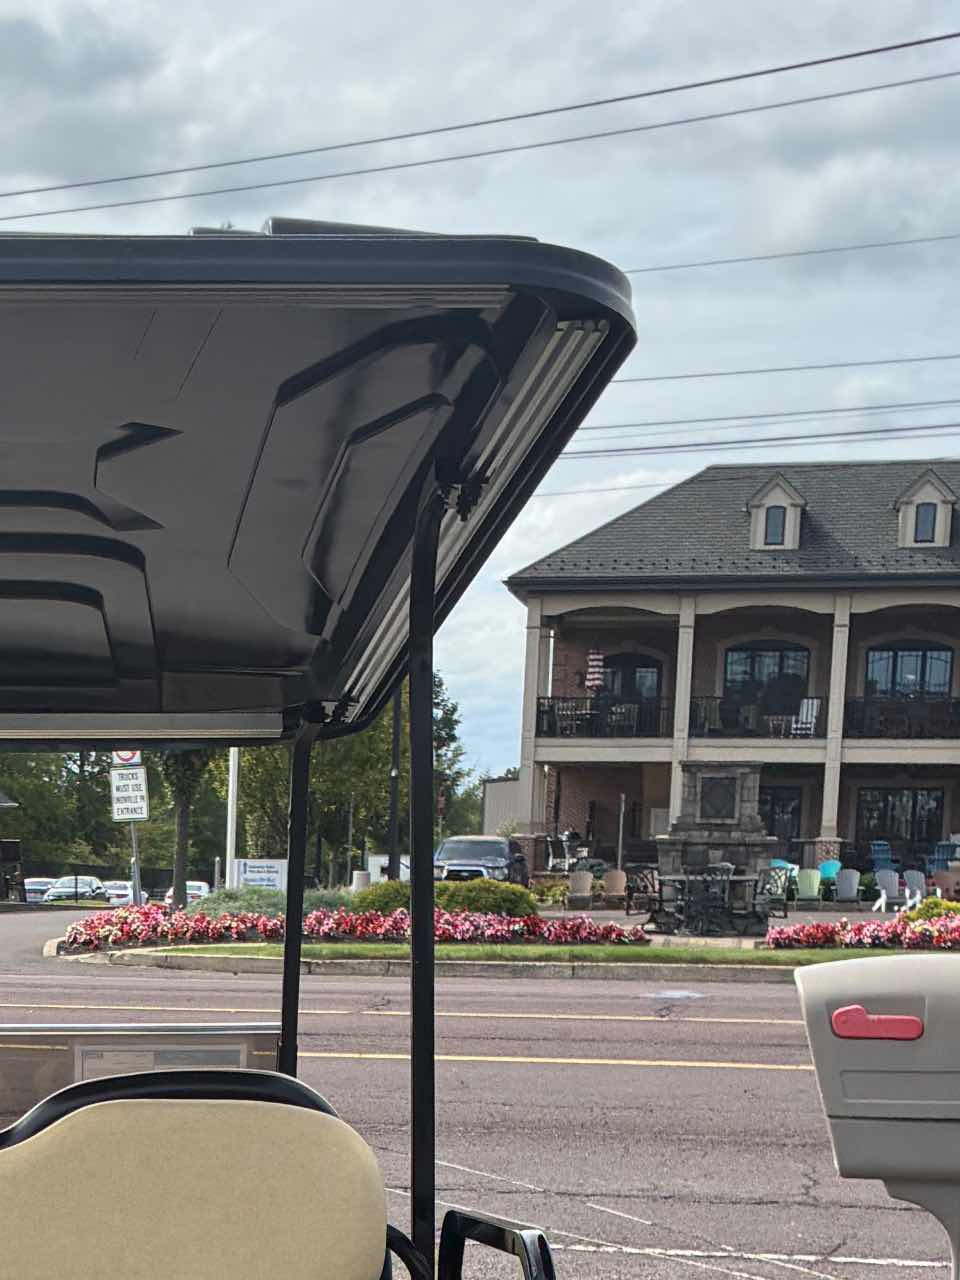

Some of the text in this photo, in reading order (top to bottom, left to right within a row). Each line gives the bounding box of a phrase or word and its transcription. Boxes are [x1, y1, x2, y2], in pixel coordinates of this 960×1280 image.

[115, 783, 143, 792] MUST USE
[116, 806, 144, 816] ENTRANCE
